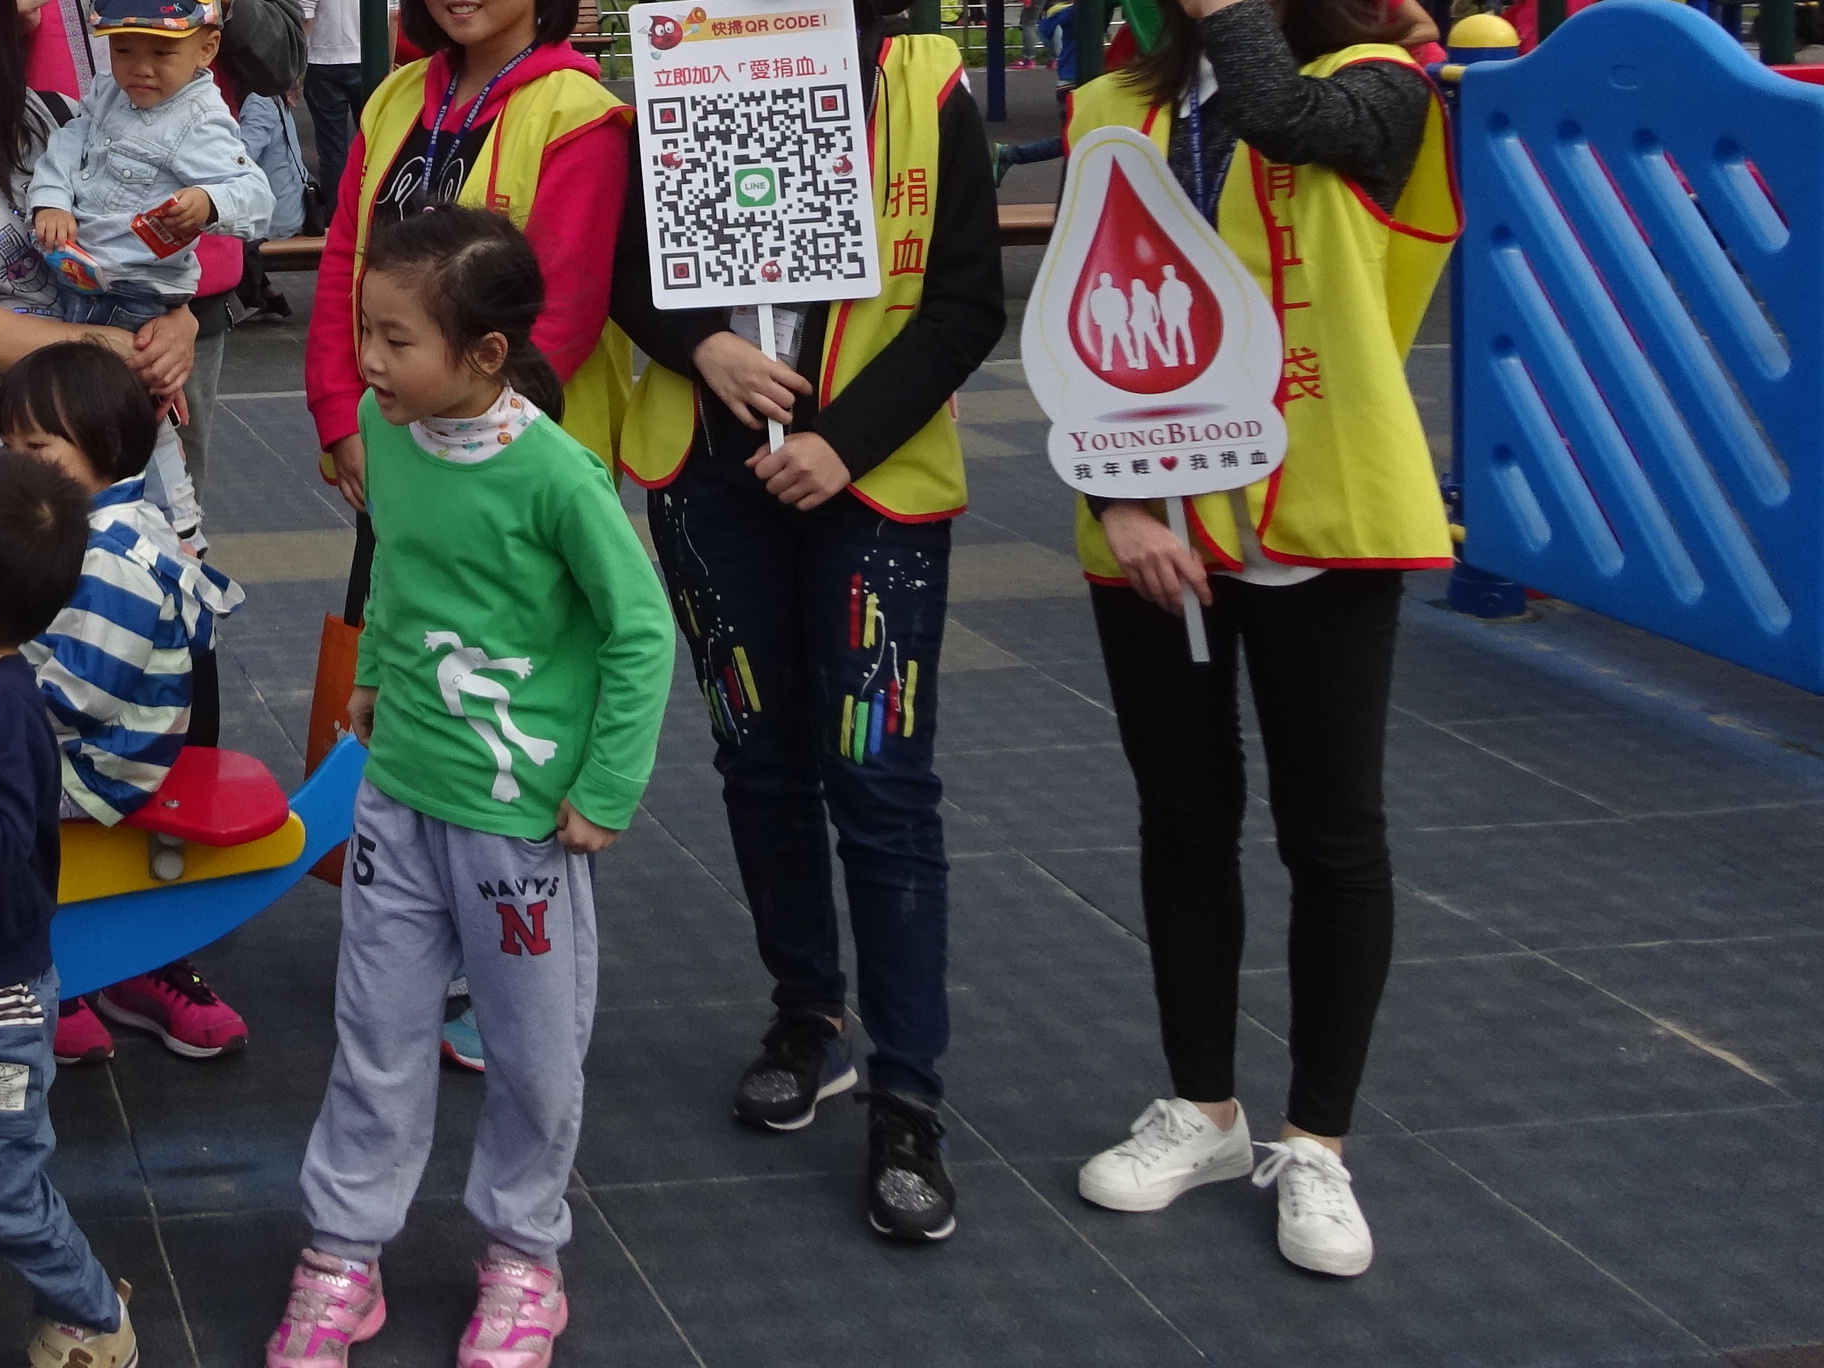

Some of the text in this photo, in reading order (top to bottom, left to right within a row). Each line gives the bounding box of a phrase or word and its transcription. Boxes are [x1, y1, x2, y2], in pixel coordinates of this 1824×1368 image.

[711, 14, 828, 37] 快掃QR CODE!
[744, 181, 766, 192] LINE
[885, 168, 928, 313] 捐血一
[1189, 450, 1270, 471] 我捐血
[496, 899, 551, 956] N
